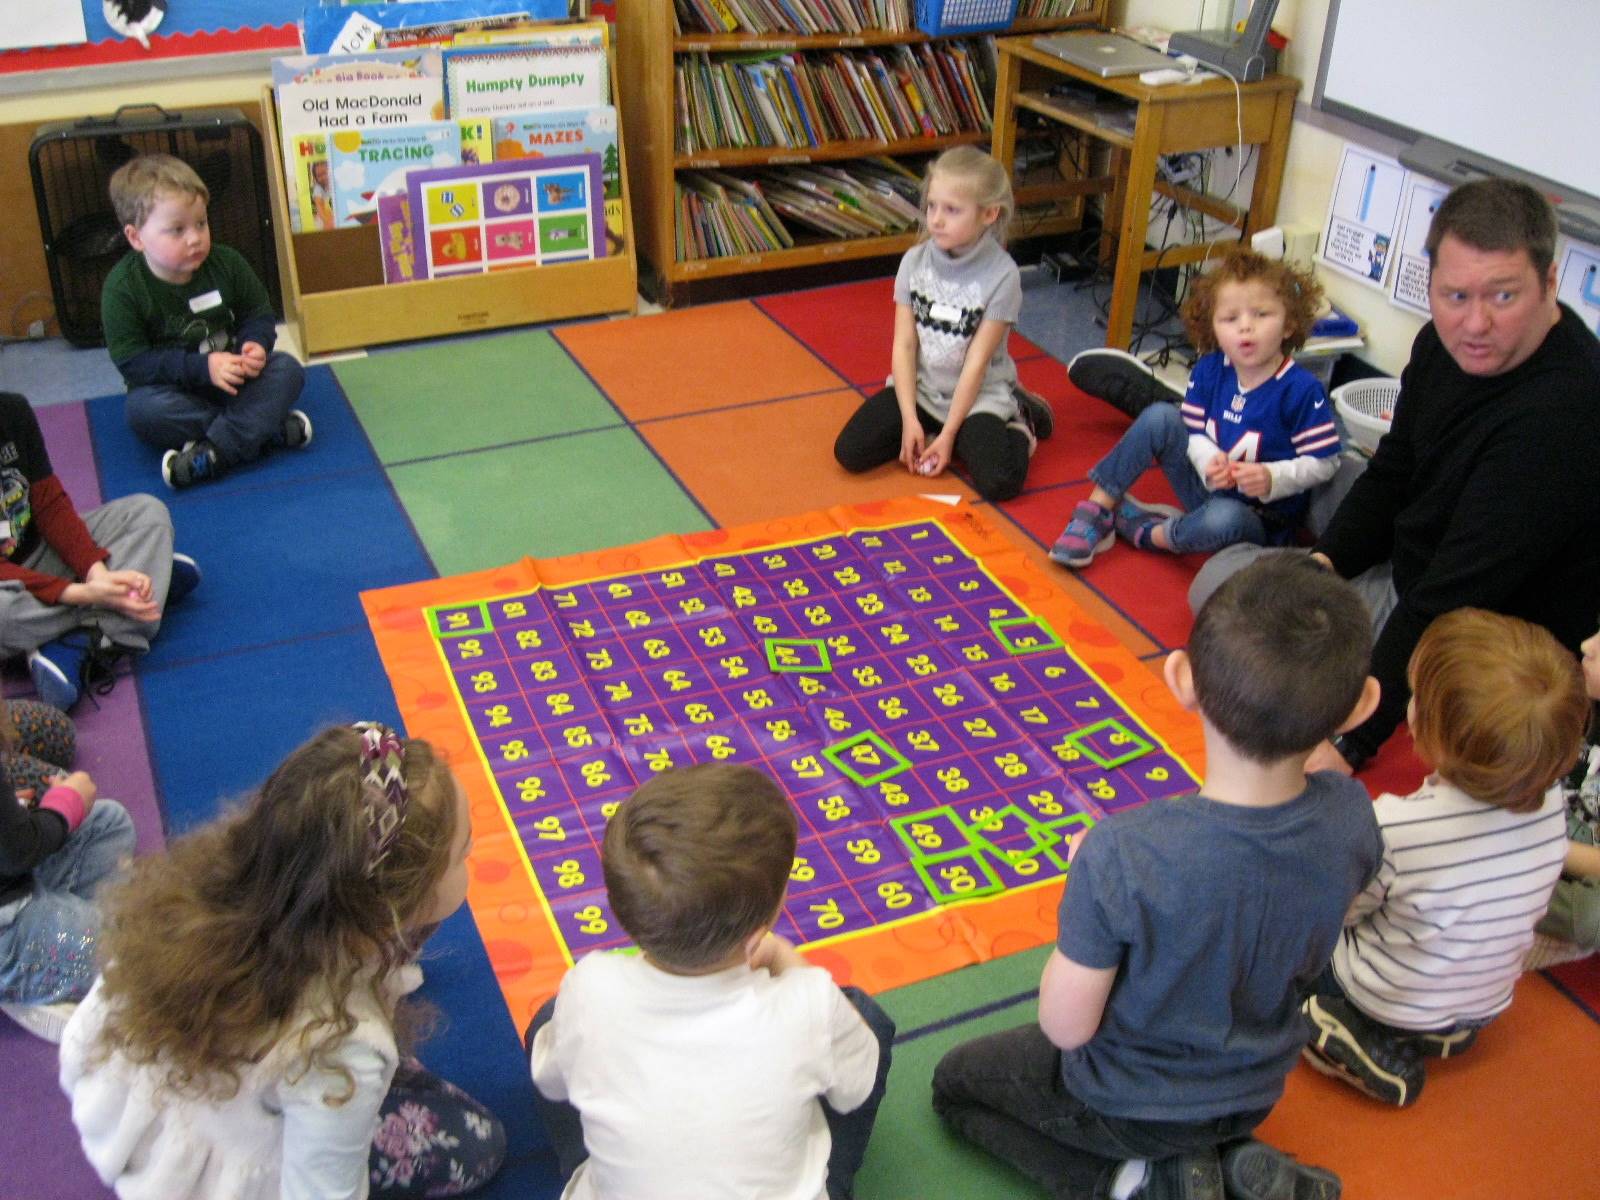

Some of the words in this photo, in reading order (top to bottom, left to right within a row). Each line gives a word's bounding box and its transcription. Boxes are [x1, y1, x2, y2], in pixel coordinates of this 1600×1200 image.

[465, 77, 523, 94] Humpty
[528, 71, 585, 89] Dumpty
[302, 97, 329, 113] Old
[335, 93, 422, 110] MacDonald
[318, 114, 349, 128] Had
[355, 115, 366, 126] a
[372, 111, 408, 124] Farm
[528, 129, 584, 145] MAZES
[358, 143, 435, 163] TRACING
[863, 537, 882, 547] 11
[912, 530, 929, 539] 1
[763, 555, 787, 569] 31
[813, 544, 837, 560] 21
[934, 555, 954, 564] 2
[834, 566, 861, 585] 22
[884, 560, 907, 574] 12
[661, 572, 686, 588] 51
[784, 579, 810, 597] 32
[960, 581, 980, 591] 3
[554, 592, 577, 608] 71
[608, 583, 633, 598] 61
[733, 586, 757, 608] 42
[908, 587, 933, 603] 13
[503, 602, 528, 618] 81
[680, 597, 705, 615] 52
[856, 593, 885, 615] 23
[990, 608, 1008, 618] 4
[447, 612, 471, 628] 91
[625, 610, 652, 628] 62
[754, 616, 778, 633] 43
[805, 606, 832, 625] 33
[935, 615, 960, 631] 14
[569, 620, 596, 637] 72
[699, 627, 727, 647] 53
[881, 624, 910, 645] 24
[458, 639, 484, 659] 92
[516, 630, 543, 649] 82
[644, 639, 671, 659] 63
[828, 636, 856, 656] 34
[1016, 636, 1039, 648] 5
[586, 649, 613, 670] 73
[962, 644, 989, 661] 15
[531, 661, 558, 681] 83
[721, 656, 749, 678] 54
[906, 655, 938, 675] 25
[1044, 666, 1065, 678] 6
[471, 671, 498, 692] 93
[663, 670, 692, 691] 64
[799, 677, 825, 695] 45
[852, 666, 882, 687] 35
[990, 673, 1015, 692] 16
[604, 681, 633, 702] 74
[743, 689, 773, 709] 55
[934, 684, 963, 706] 26
[547, 693, 575, 715] 84
[878, 697, 908, 719] 36
[1076, 697, 1100, 708] 7
[485, 704, 513, 727] 94
[685, 703, 715, 724] 65
[825, 708, 851, 731] 46
[1021, 707, 1049, 724] 17
[624, 715, 654, 736] 75
[767, 720, 796, 741] 56
[963, 718, 997, 738] 27
[564, 726, 593, 747] 85
[908, 731, 940, 751] 37
[500, 740, 530, 761] 95
[706, 735, 737, 759] 66
[1052, 741, 1081, 761] 18
[644, 749, 673, 773] 76
[792, 755, 825, 778] 57
[995, 753, 1028, 778] 28
[582, 760, 610, 787] 86
[937, 768, 970, 793] 38
[1146, 767, 1169, 781] 9
[517, 777, 545, 802] 96
[880, 781, 910, 806] 48
[1088, 779, 1116, 800] 19
[818, 796, 851, 821] 58
[1028, 791, 1064, 816] 29
[534, 816, 566, 841] 97
[911, 822, 943, 848] 49
[847, 839, 881, 864] 59
[554, 860, 586, 888] 98
[941, 866, 977, 893] 50
[878, 881, 913, 909] 60
[575, 906, 609, 935] 99
[810, 899, 845, 928] 70
